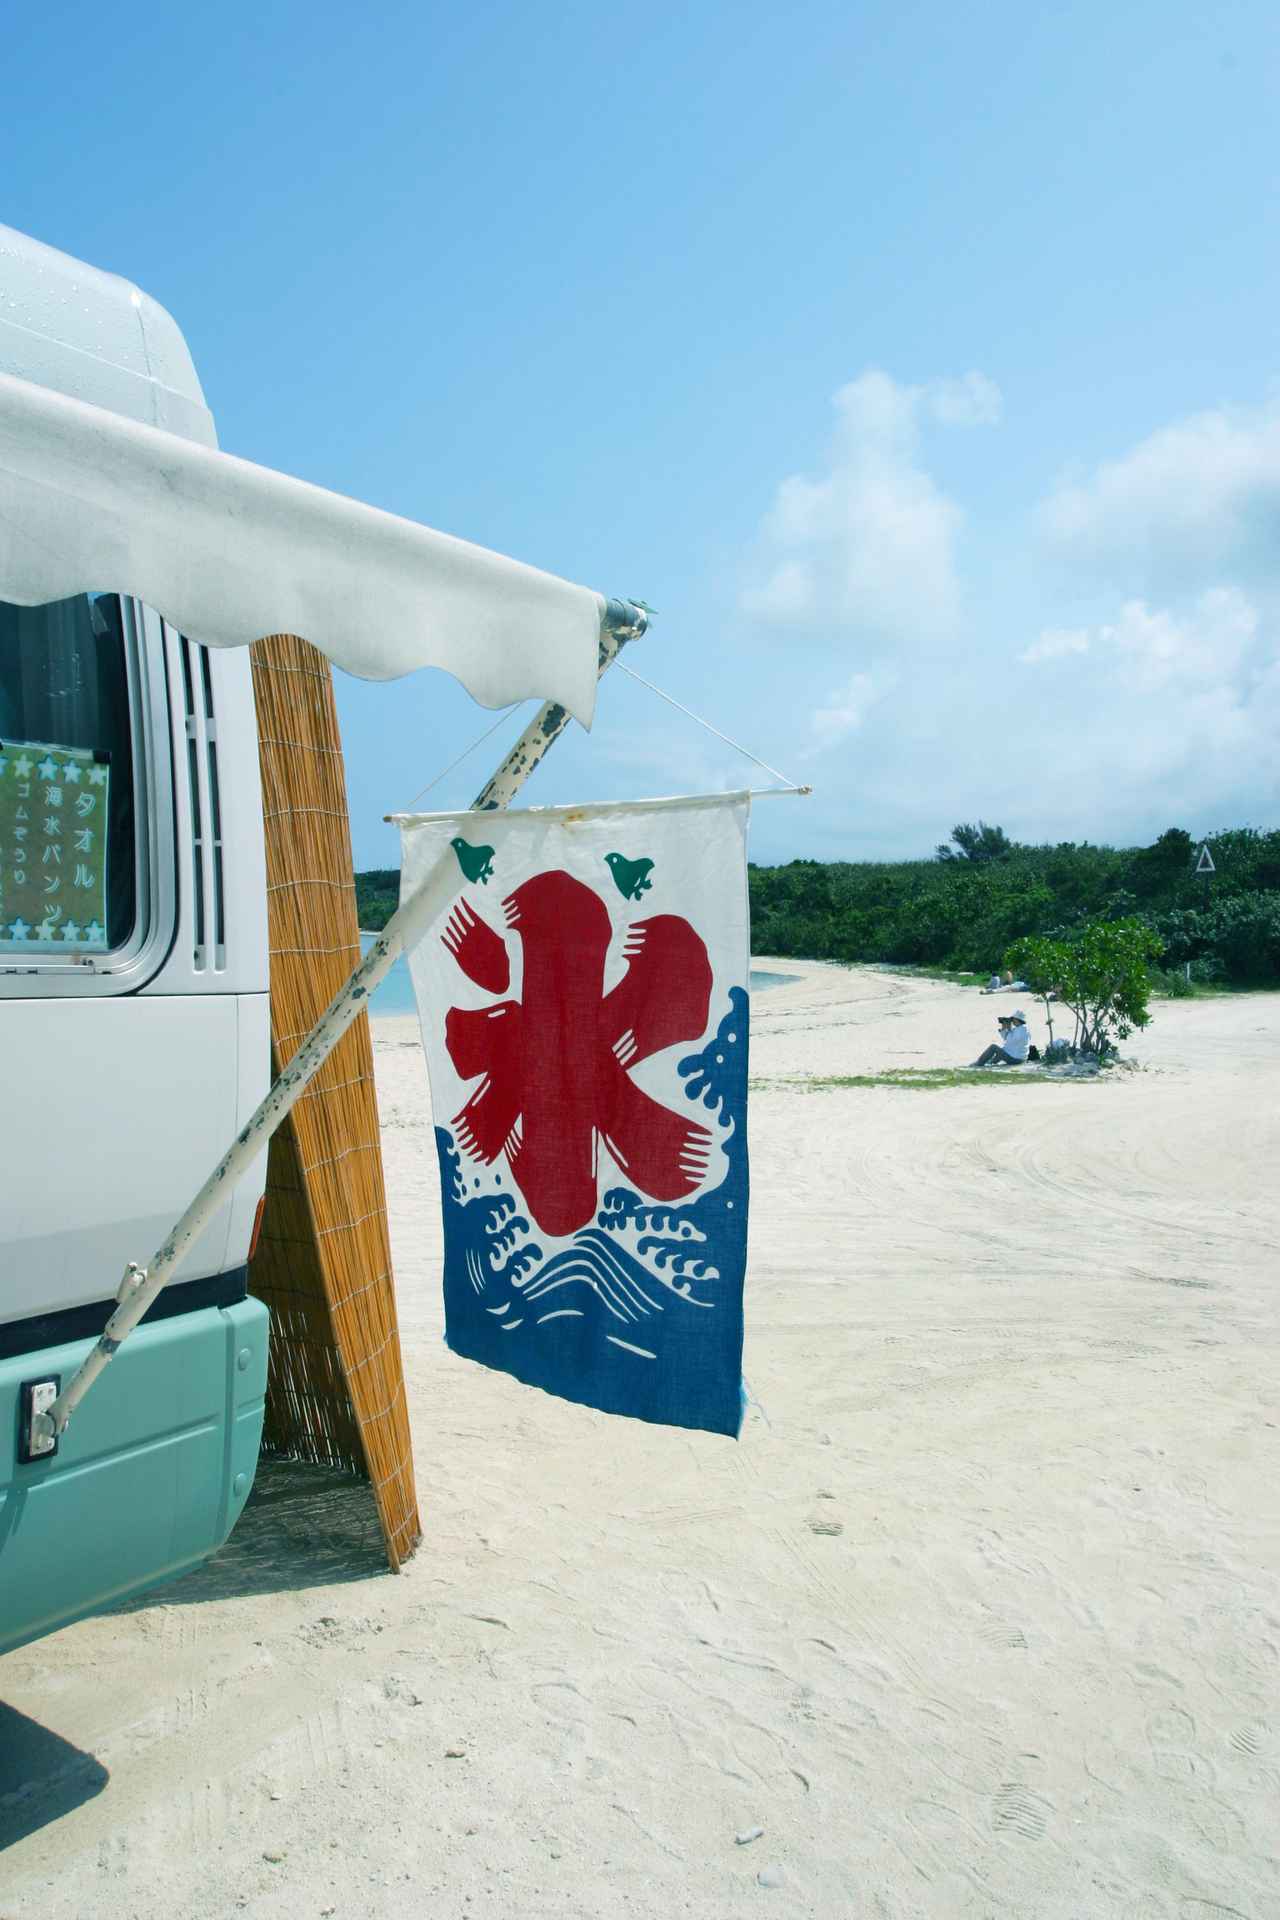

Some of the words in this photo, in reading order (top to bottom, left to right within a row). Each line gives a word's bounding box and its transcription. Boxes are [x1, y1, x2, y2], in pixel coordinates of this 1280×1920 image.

[42, 785, 64, 922] 海水パンツ
[73, 791, 97, 888] タオル
[440, 868, 714, 1237] 氷
